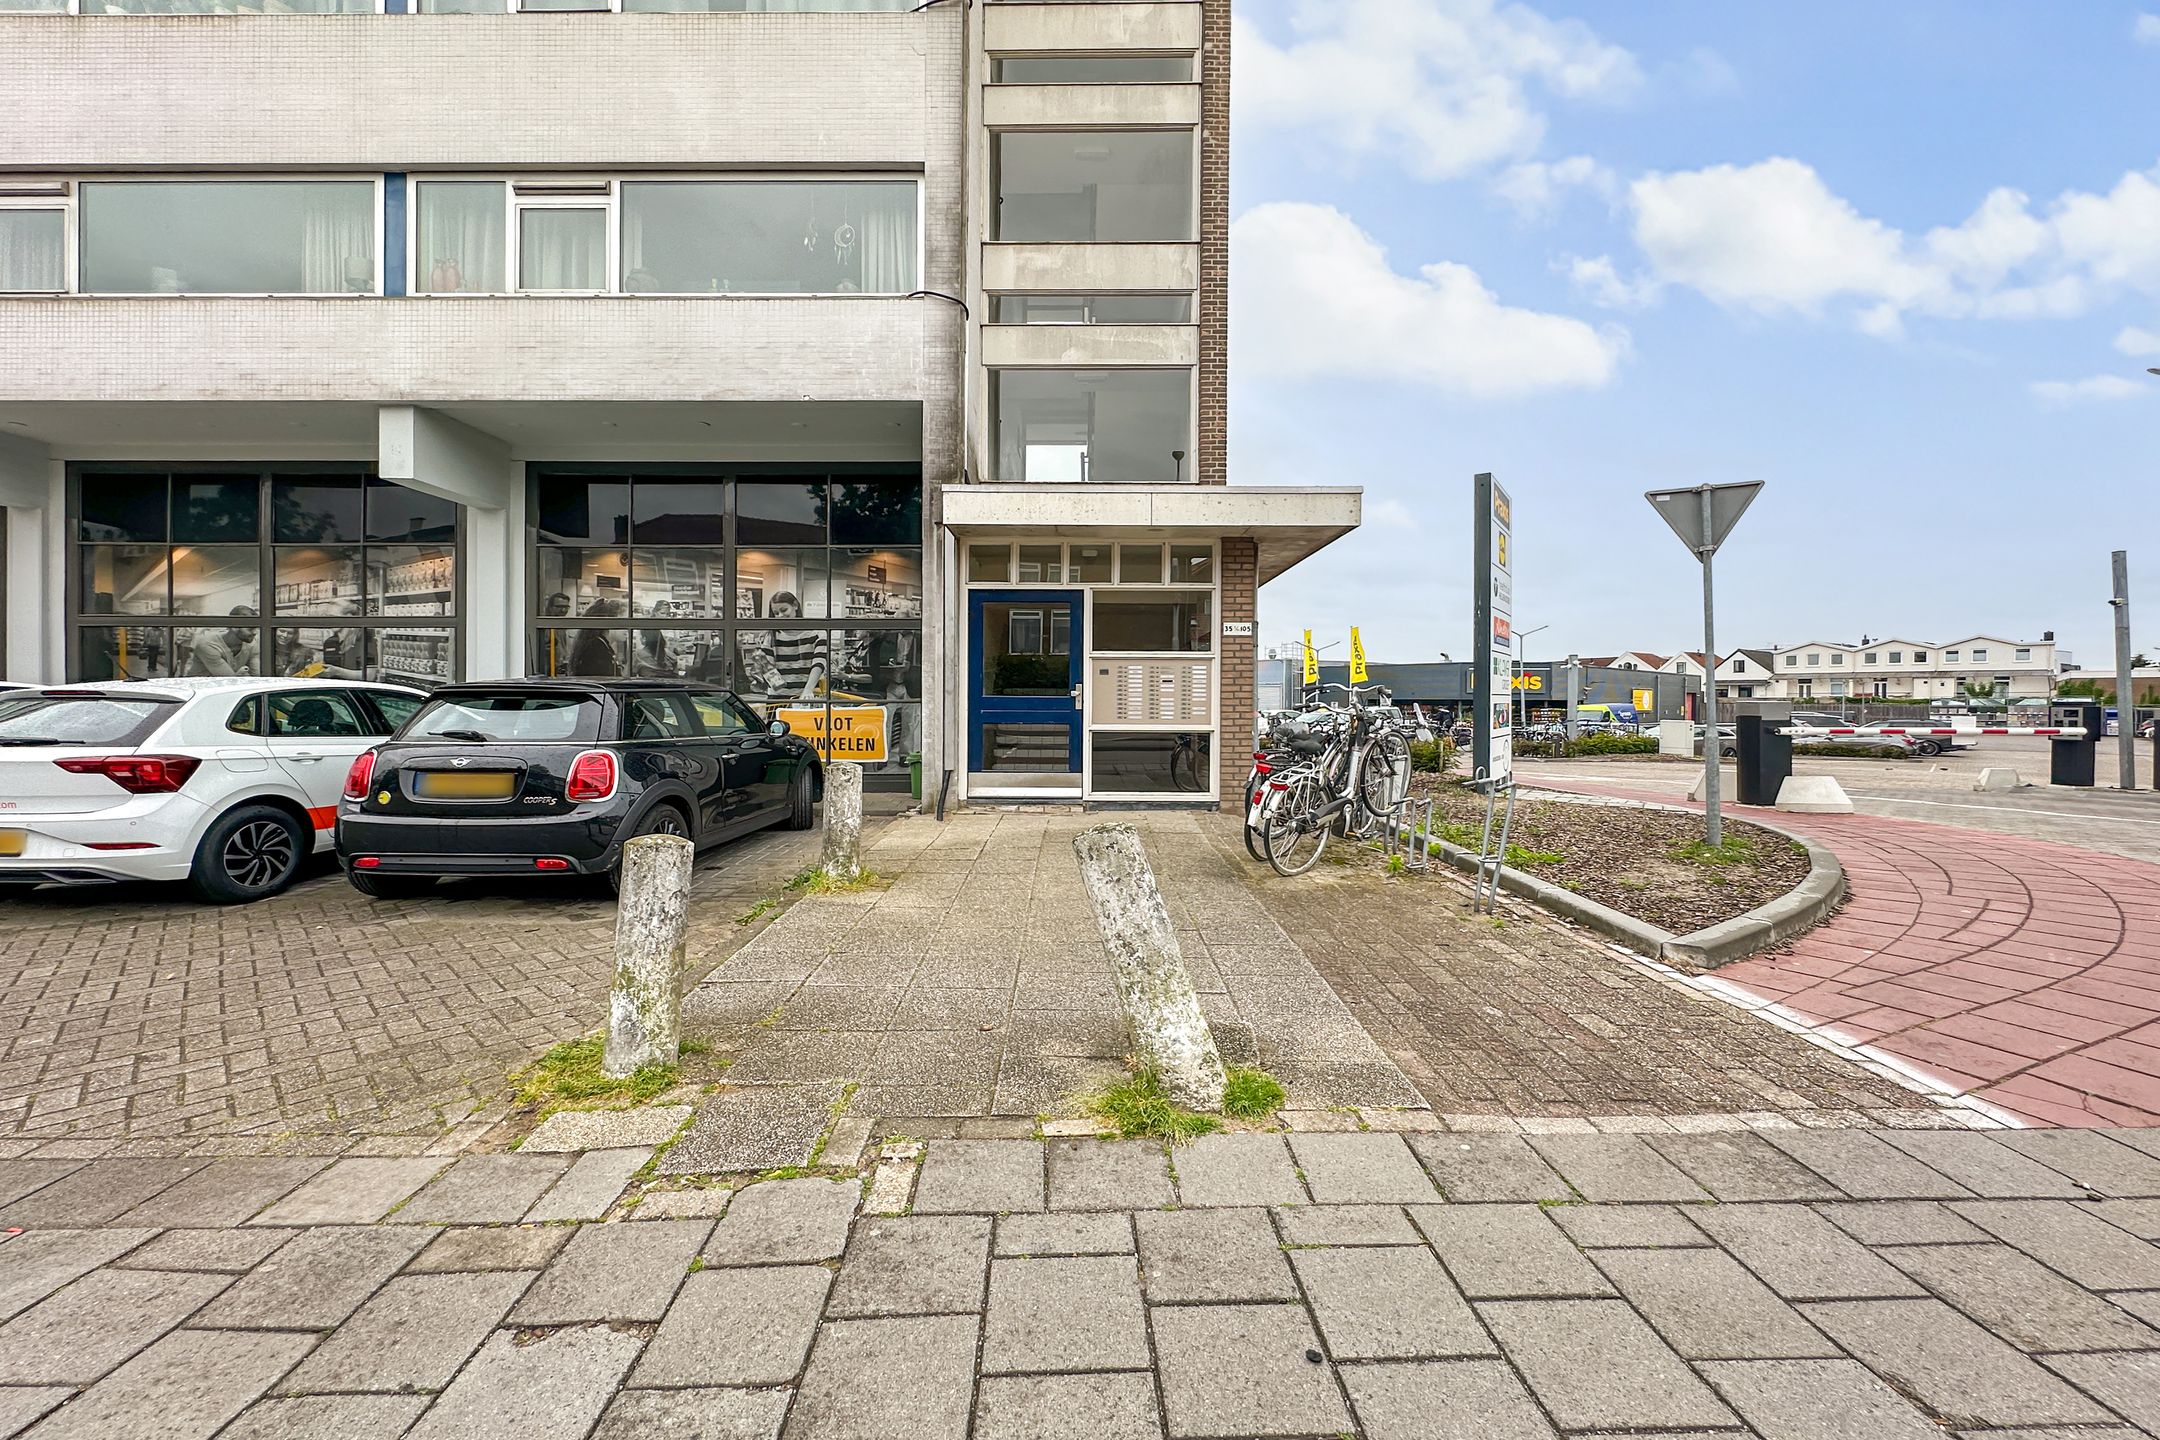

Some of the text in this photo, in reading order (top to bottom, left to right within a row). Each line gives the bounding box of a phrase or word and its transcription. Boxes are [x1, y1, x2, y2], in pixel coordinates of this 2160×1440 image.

[814, 718, 853, 731] VOT
[806, 736, 875, 751] INKELEN
[0, 801, 17, 809] om
